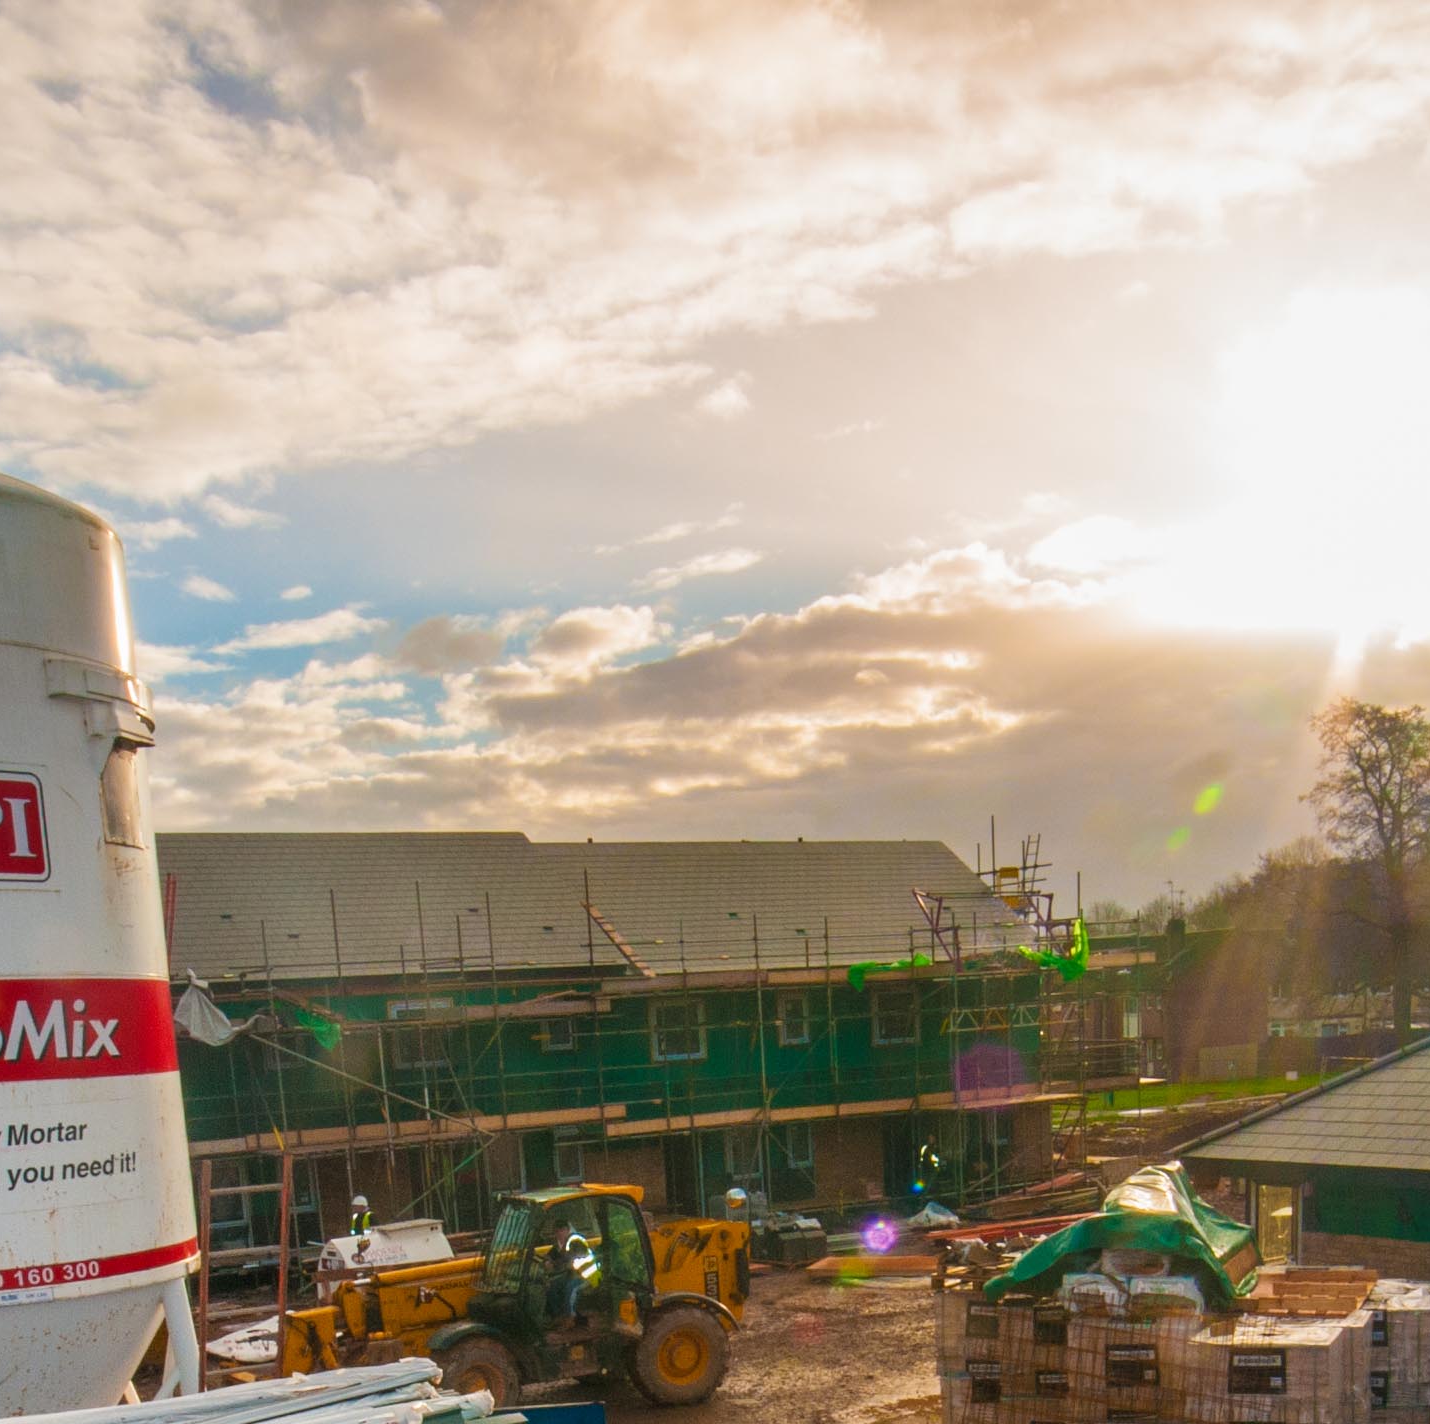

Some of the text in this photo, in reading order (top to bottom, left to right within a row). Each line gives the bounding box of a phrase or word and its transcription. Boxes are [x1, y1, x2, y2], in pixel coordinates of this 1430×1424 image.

[7, 1121, 87, 1147] Mortar
[7, 1162, 55, 1189] you
[62, 1156, 114, 1183] need
[118, 1151, 137, 1174] it!
[13, 1265, 55, 1287] 160
[62, 1260, 100, 1281] 300
